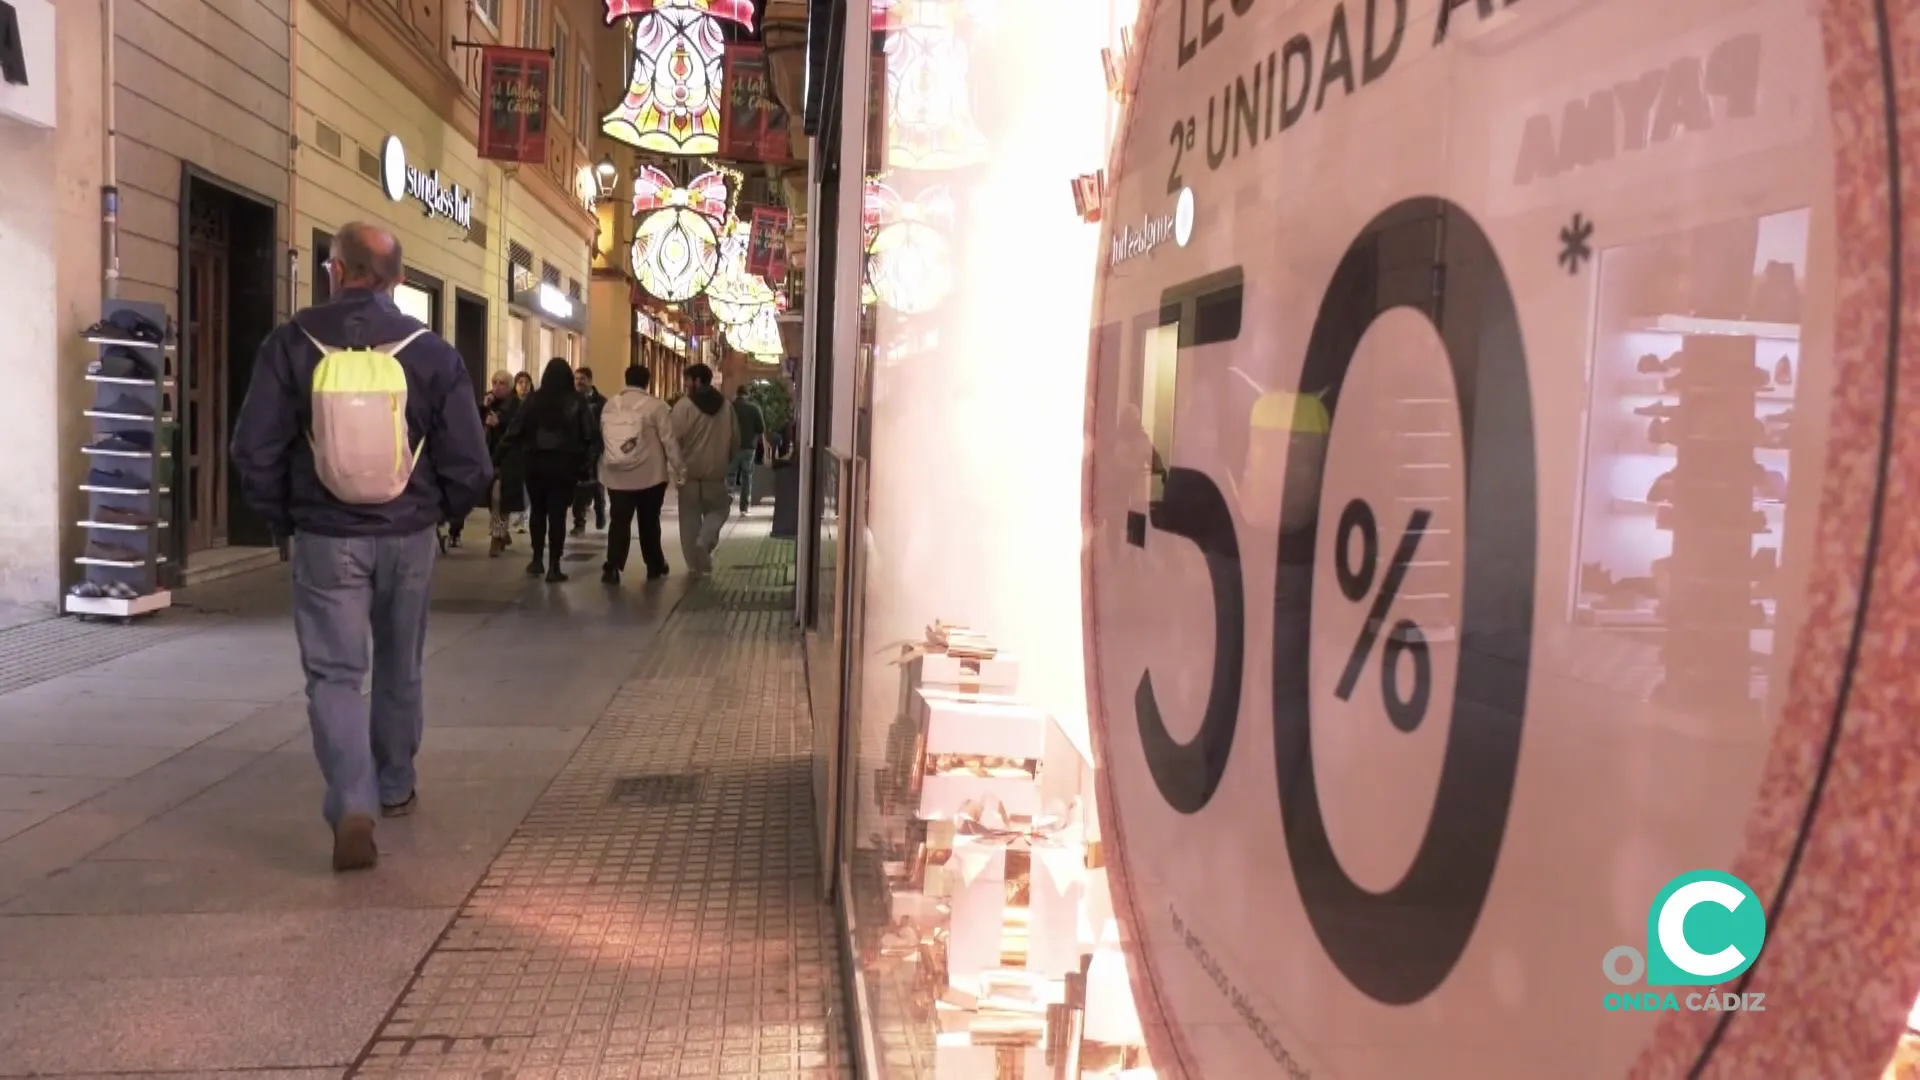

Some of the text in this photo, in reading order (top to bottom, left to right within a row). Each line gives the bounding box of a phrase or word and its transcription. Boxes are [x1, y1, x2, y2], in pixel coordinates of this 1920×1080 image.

[1177, 0, 1255, 70] LE
[1206, 0, 1407, 171] UNIDAD
[407, 164, 472, 230] sunglass hut
